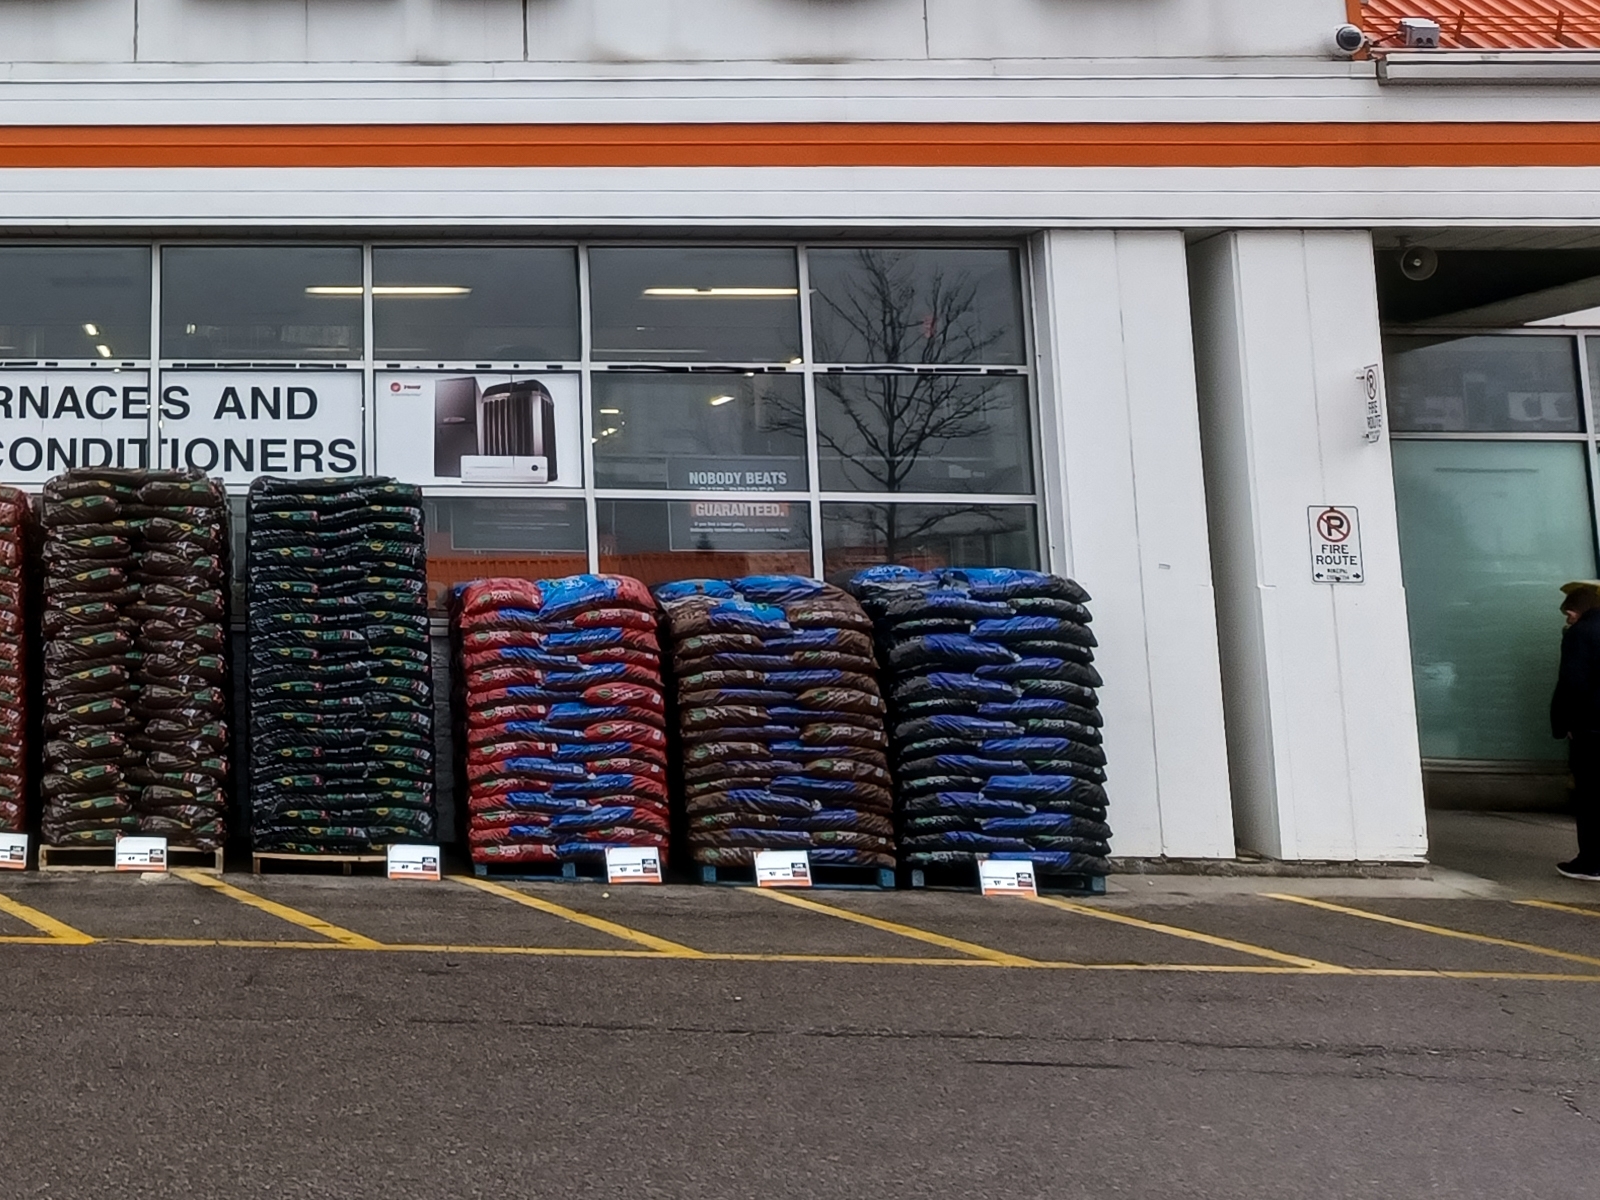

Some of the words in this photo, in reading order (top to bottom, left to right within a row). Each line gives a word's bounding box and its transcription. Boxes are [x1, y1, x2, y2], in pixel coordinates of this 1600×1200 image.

[213, 385, 318, 420] AND
[689, 471, 742, 485] NOBODY
[745, 471, 788, 485] BEATS
[695, 503, 785, 517] GUARANTEED.
[1321, 544, 1350, 555] FIRE
[1315, 555, 1358, 566] ROUTE
